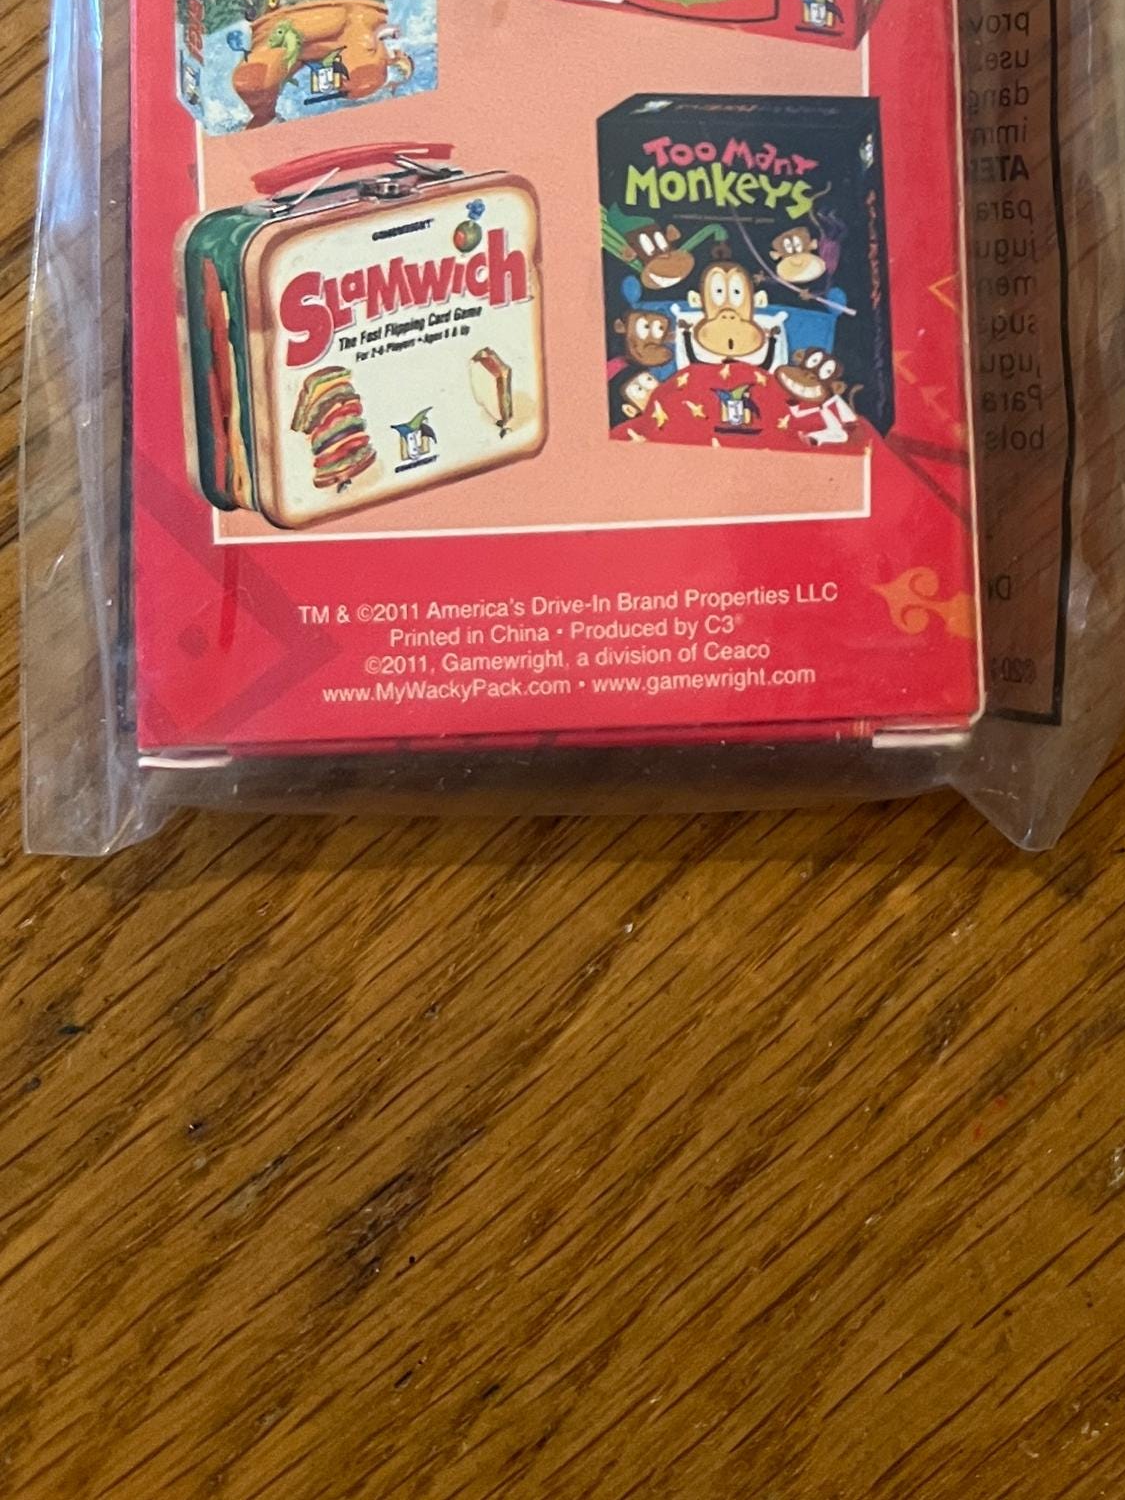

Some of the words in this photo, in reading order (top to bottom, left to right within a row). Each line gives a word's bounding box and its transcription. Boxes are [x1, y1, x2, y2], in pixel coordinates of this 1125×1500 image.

[625, 163, 813, 219] Monkeys
[339, 336, 357, 351] The
[361, 327, 382, 345] Fast
[428, 309, 451, 327] Card
[453, 306, 483, 321] Game
[298, 605, 329, 625] TM
[336, 604, 351, 624] &
[357, 601, 419, 623] ©2011
[426, 598, 526, 620] America's
[532, 594, 610, 616] Drive-In
[617, 590, 678, 612] Brand
[685, 586, 790, 611] Properties
[796, 582, 838, 604] LLC
[390, 627, 461, 648] Printed
[467, 628, 484, 645] in
[490, 624, 550, 645] China
[570, 618, 668, 640] Produced
[674, 617, 699, 640] by
[577, 650, 589, 667] a
[596, 644, 672, 666] division
[678, 642, 698, 662] of
[703, 641, 771, 661] Ceaco
[322, 677, 571, 705] www.MyWackyPack.com
[592, 667, 817, 696] www.gamewright.com
